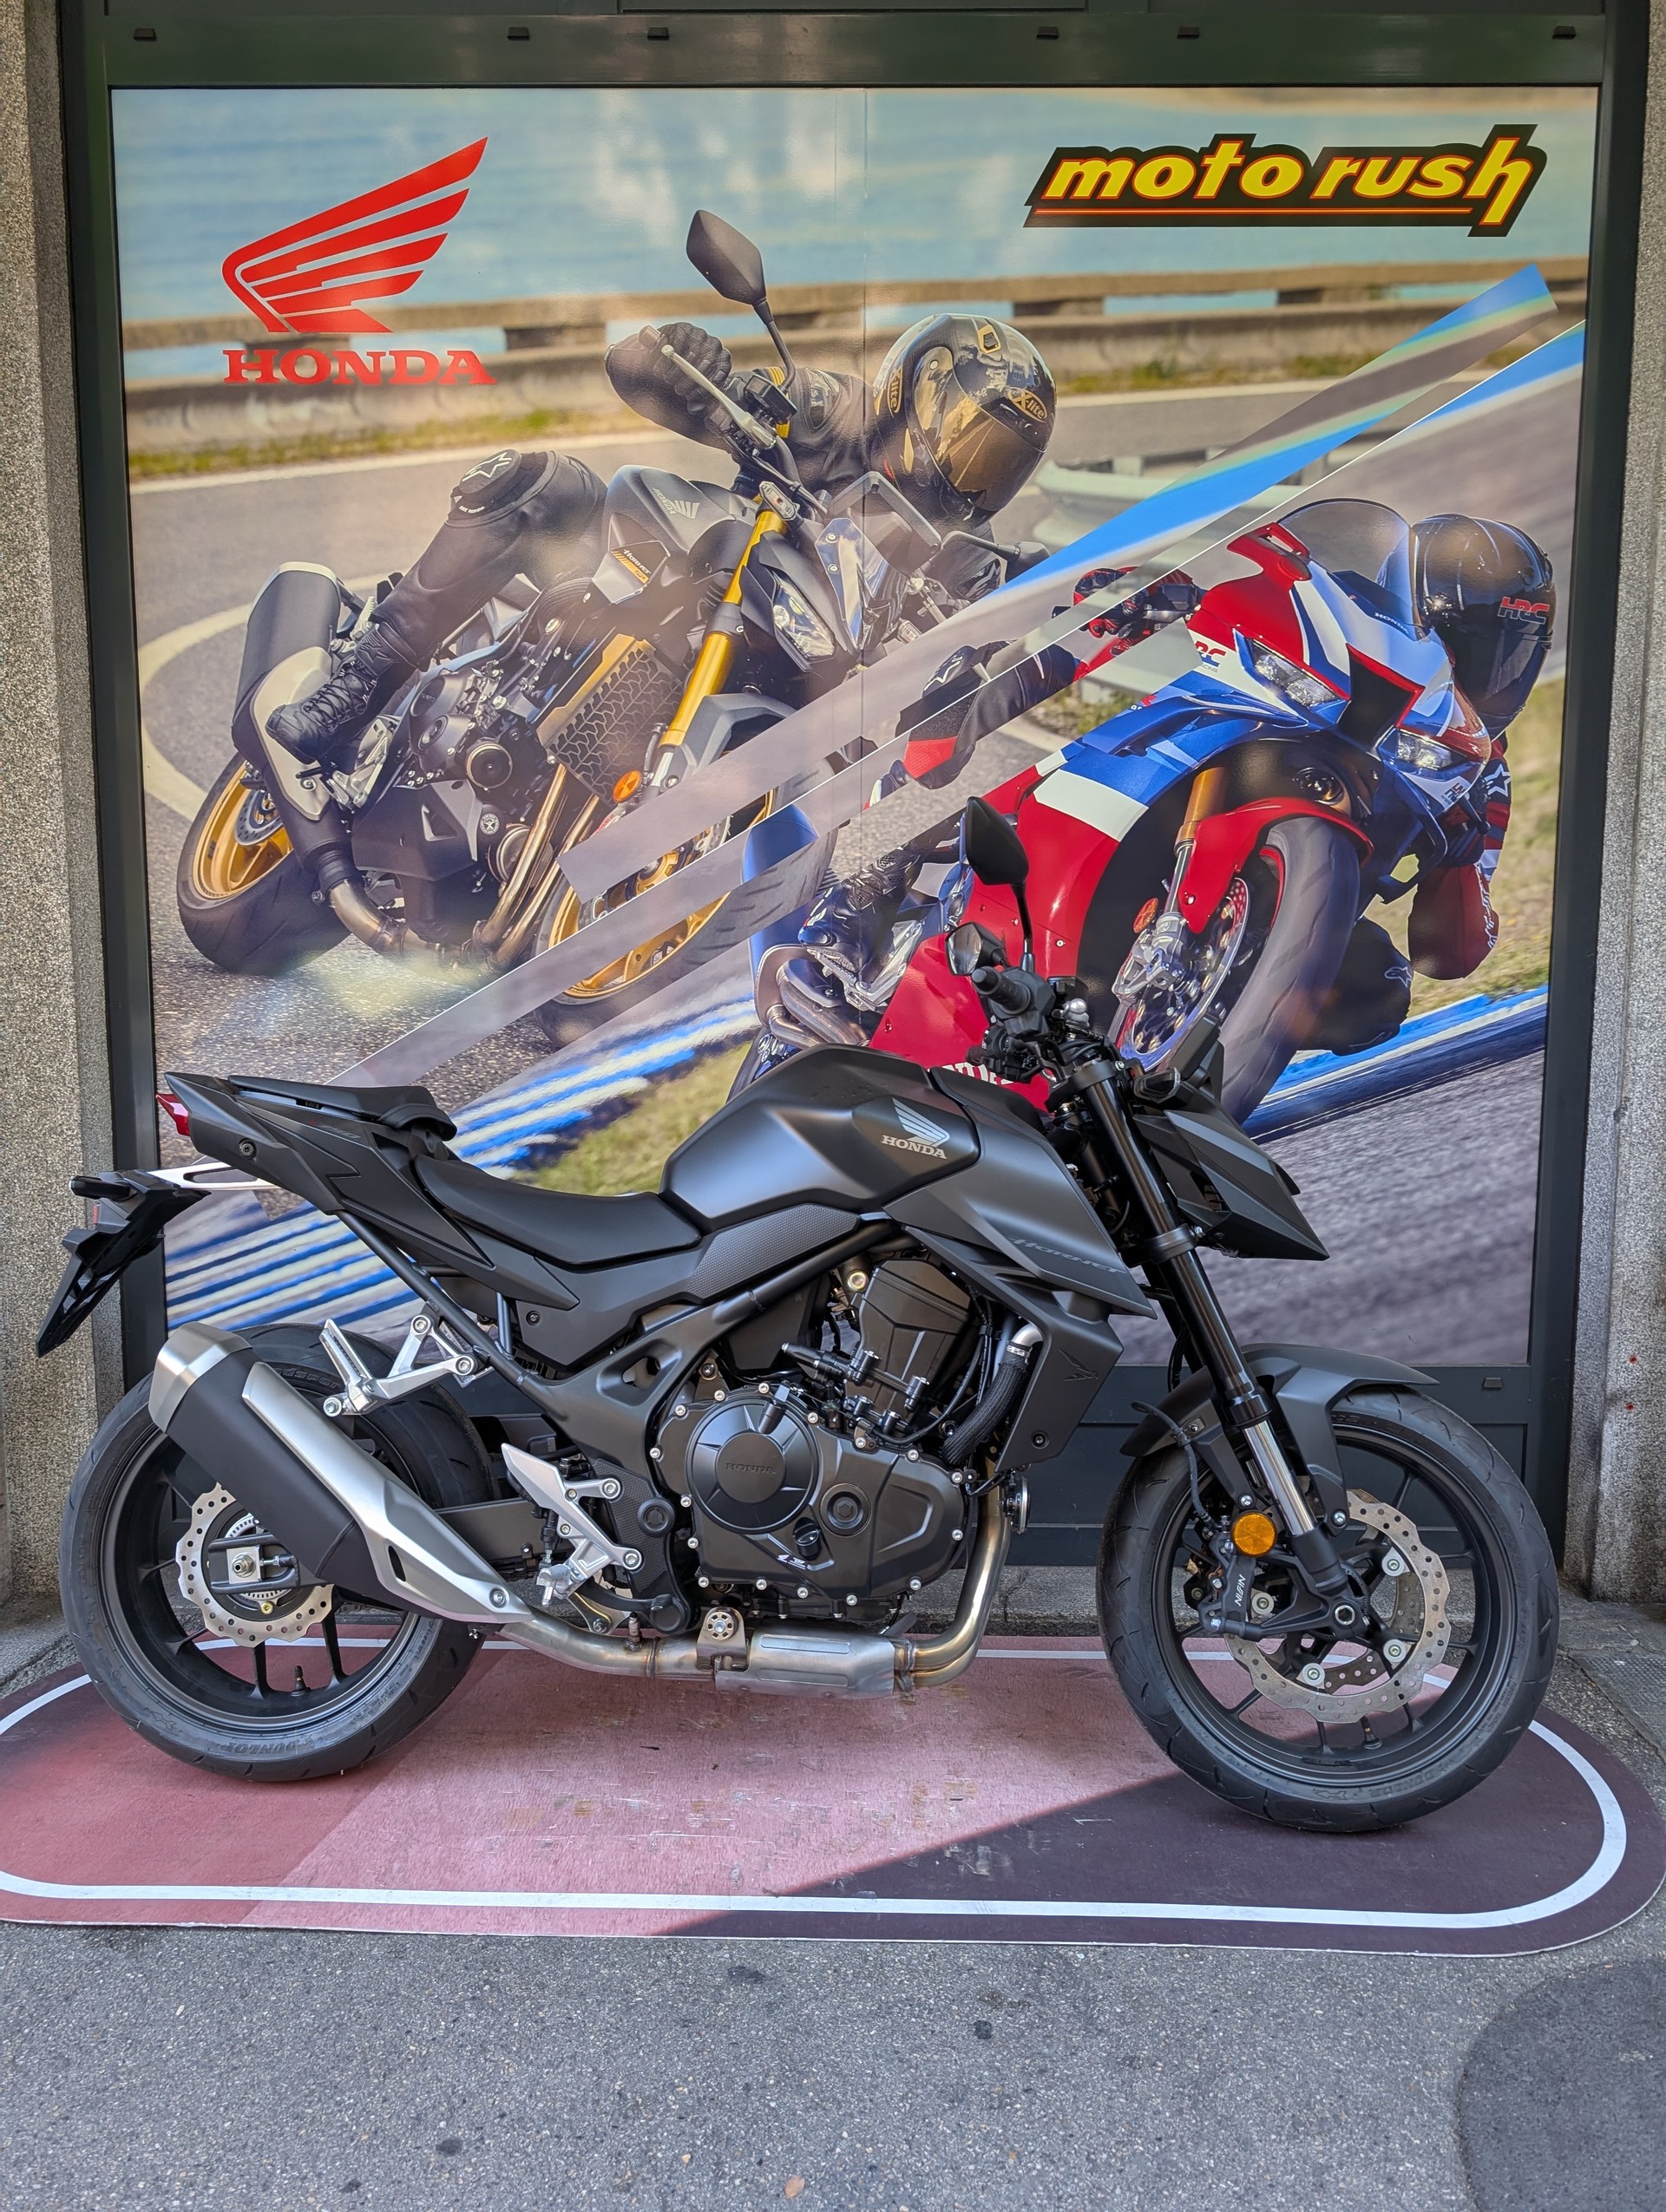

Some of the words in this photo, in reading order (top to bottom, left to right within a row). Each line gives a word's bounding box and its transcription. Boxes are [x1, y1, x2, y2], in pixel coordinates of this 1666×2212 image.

[1041, 140, 1304, 200] moto
[1309, 136, 1499, 226] rush
[222, 348, 497, 385] HONDA
[1012, 389, 1045, 419] X-lite
[1374, 612, 1409, 634] HONDA
[1497, 596, 1551, 625] HRC
[1195, 640, 1227, 668] RC
[881, 1135, 948, 1160] HONDA
[1008, 1238, 1127, 1273] HORNET
[725, 1462, 777, 1475] HONDA
[222, 1739, 300, 1755] DUNLOP
